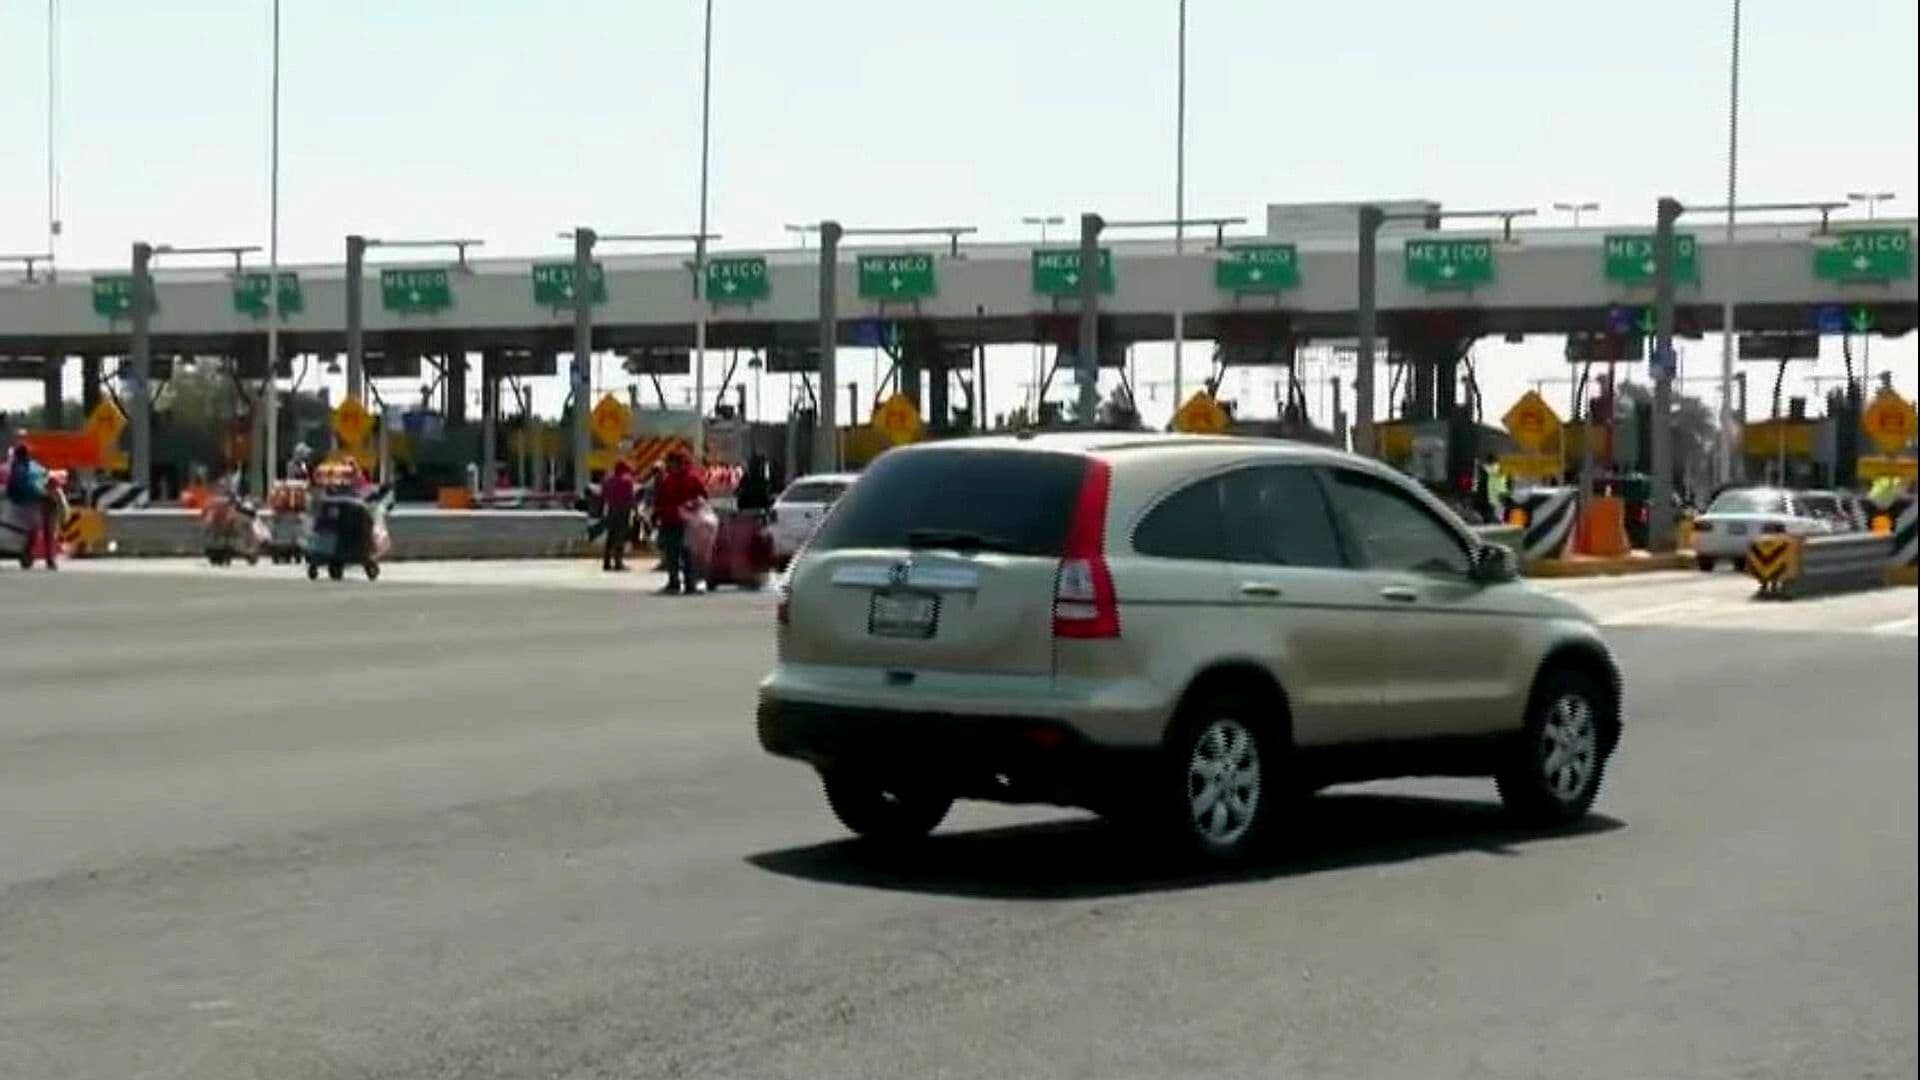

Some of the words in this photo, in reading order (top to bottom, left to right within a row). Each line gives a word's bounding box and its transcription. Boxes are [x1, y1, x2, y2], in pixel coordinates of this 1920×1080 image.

[1608, 242, 1691, 259] MEXO
[1832, 234, 1906, 253] EXICO
[1408, 244, 1487, 262] MEXICO
[708, 261, 763, 279] EXICO
[863, 257, 928, 273] MEXICO
[384, 271, 446, 289] MEXICO
